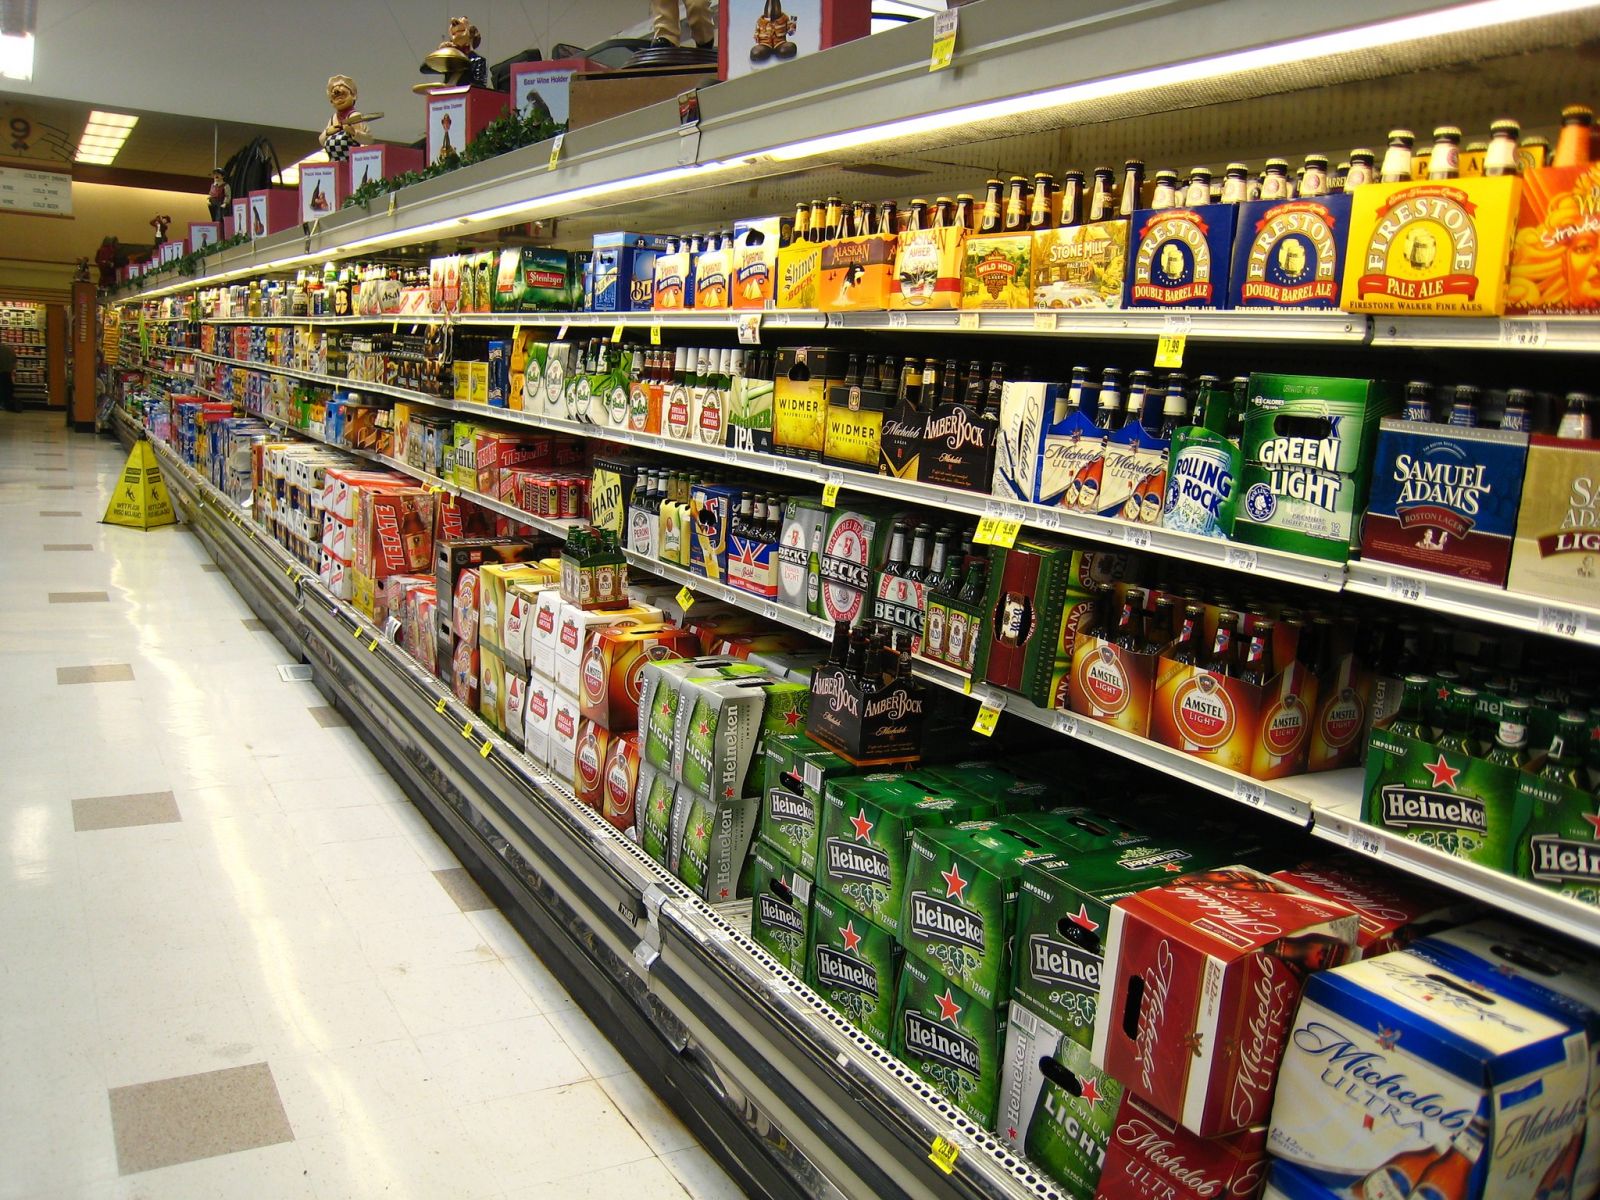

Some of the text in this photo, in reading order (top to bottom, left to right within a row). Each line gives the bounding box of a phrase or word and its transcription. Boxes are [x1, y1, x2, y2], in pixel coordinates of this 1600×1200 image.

[9, 117, 31, 139] 9
[1049, 240, 1112, 262] STONE MILL
[1136, 221, 1208, 280] FIRESTONE
[1248, 213, 1334, 278] FIRESTONE
[1367, 198, 1474, 271] FIRESTONE
[978, 263, 1013, 274] WILD HOP
[1134, 284, 1208, 302] DOUBLE BARREL ALE
[1245, 283, 1333, 302] DOUBLE BARREL ALE
[1386, 277, 1444, 298] PALE ALE
[1350, 302, 1395, 310] FIRESTONE
[1397, 302, 1433, 311] WALKER
[1435, 303, 1457, 311] FINE
[1459, 303, 1483, 312] ALES
[778, 398, 819, 412] WIDMER
[734, 424, 754, 452] IPA
[831, 421, 875, 439] WIDMER
[1044, 443, 1101, 463] Michelob
[1105, 451, 1162, 476] Michelob
[1258, 437, 1341, 472] GREEN
[1174, 457, 1234, 498] ROLLING
[1393, 453, 1492, 494] SAMUEL
[592, 484, 621, 519] HARP
[1182, 478, 1225, 518] ROCK
[1269, 470, 1342, 513] LIGHT
[1395, 480, 1480, 515] ADAMS
[1405, 512, 1465, 533] BOSTON LAGER
[821, 556, 869, 588] BECK'S
[1090, 667, 1122, 687] AMSTEL
[1095, 682, 1117, 695] LIGHT
[1183, 697, 1223, 719] AMSTEL
[1188, 713, 1216, 727] LIGHT
[1271, 716, 1300, 728] AMSTEL
[649, 717, 674, 749] LIGHT
[722, 704, 738, 784] Heineken
[1275, 728, 1296, 738] LIGHT
[686, 738, 713, 773] LIGHT
[644, 812, 669, 846] LIGHT
[682, 838, 708, 875] LIGHT
[717, 808, 733, 885] Heineken
[1230, 952, 1275, 1128] Michelob
[1257, 980, 1287, 1092] ULTRA
[1006, 1035, 1028, 1126] Heineken
[1293, 1021, 1475, 1131] Michelob
[1320, 1066, 1432, 1145] ULTRA
[1116, 1119, 1216, 1197] Michelob
